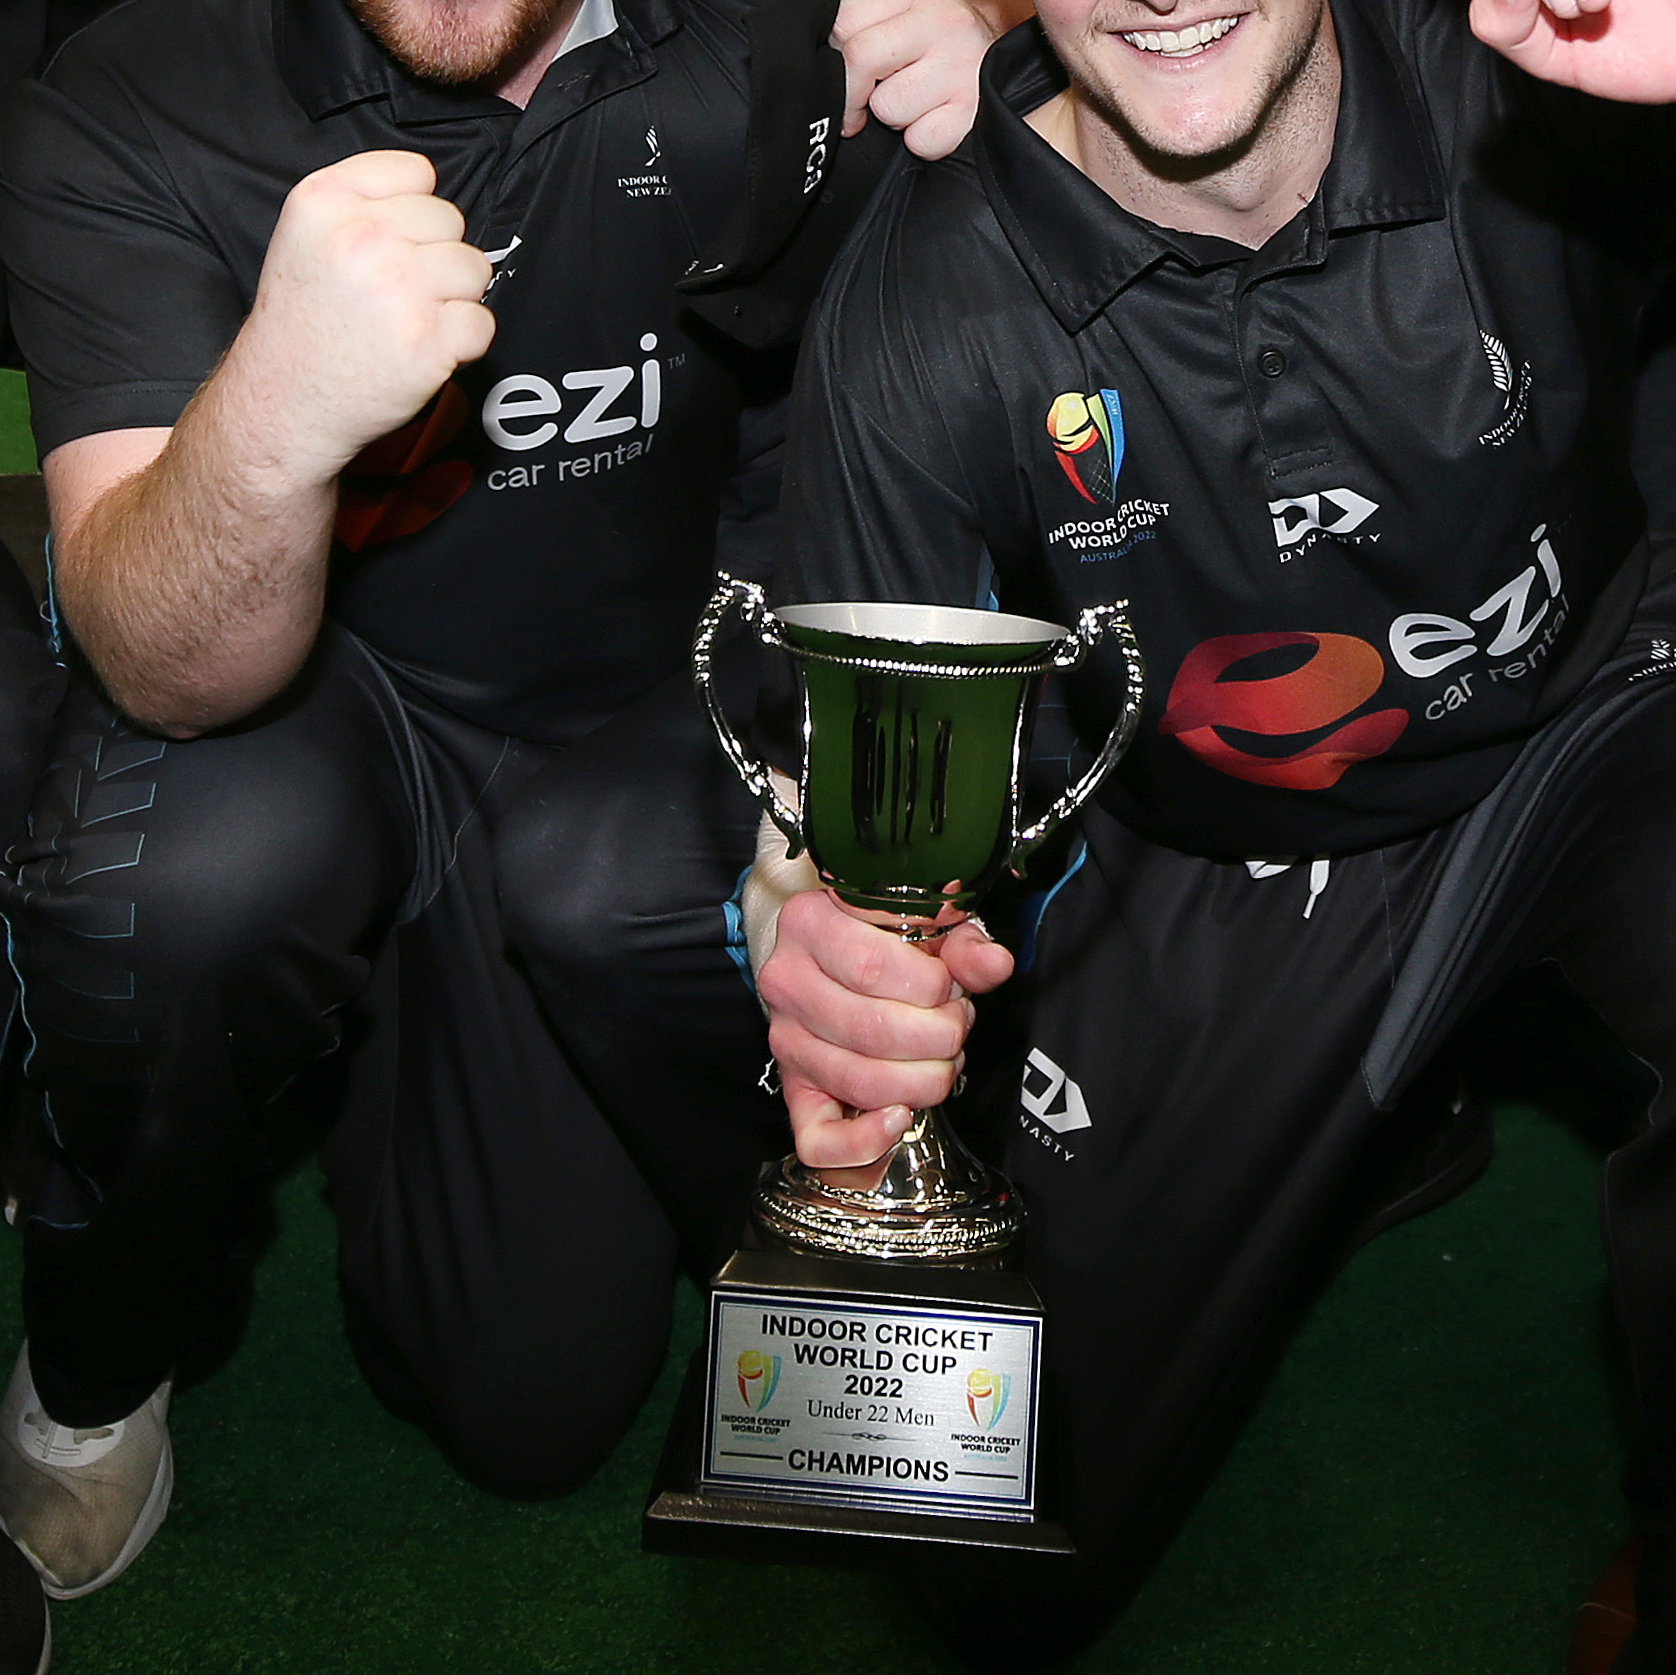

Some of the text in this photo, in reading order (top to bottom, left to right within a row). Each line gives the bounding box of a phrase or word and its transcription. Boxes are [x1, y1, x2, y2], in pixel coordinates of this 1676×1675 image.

[617, 175, 661, 188] INDOOR
[626, 187, 651, 199] NEW
[481, 332, 661, 452] ezi
[486, 433, 654, 491] car rental
[1048, 498, 1171, 546] INDOOR CRICKET
[1068, 513, 1157, 550] WORLD CUP
[1388, 523, 1563, 679] ezi
[1425, 593, 1570, 721] car rental
[761, 1314, 994, 1352] INDOOR CRICKET
[793, 1343, 957, 1375] WORLD CUP
[844, 1374, 904, 1398] 2022
[721, 1414, 791, 1427] INDOOR CRICKET
[807, 1399, 934, 1427] Under 22 Men
[731, 1424, 781, 1435] WORLD CUP
[951, 1433, 1021, 1446] INDOOR CRICKET
[961, 1443, 1011, 1454] WORLD CUP
[788, 1449, 950, 1482] CHAMPIONS
